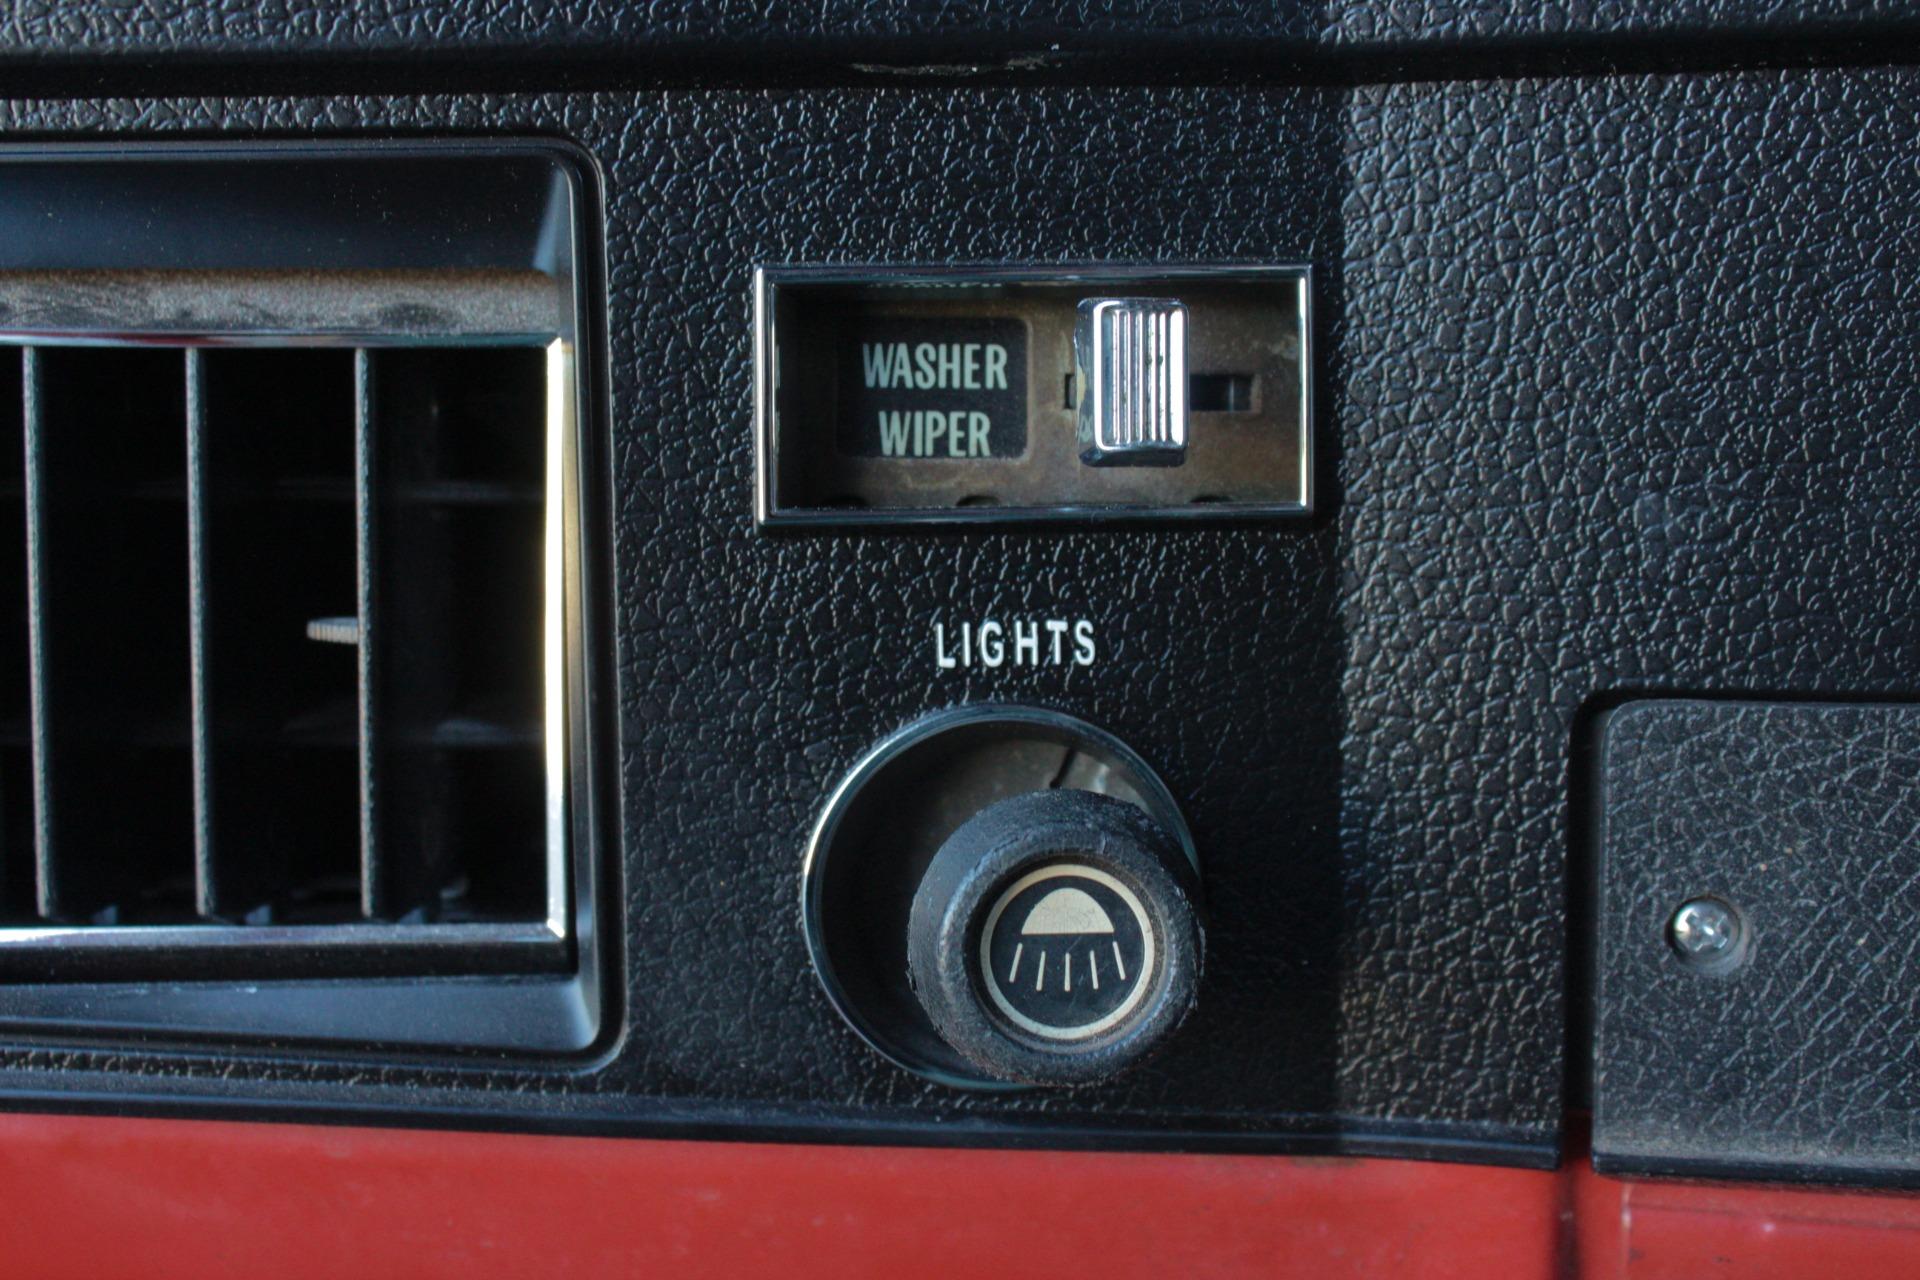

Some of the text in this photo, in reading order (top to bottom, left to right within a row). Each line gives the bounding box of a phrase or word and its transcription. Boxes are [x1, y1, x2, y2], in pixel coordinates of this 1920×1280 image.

[863, 343, 1008, 389] WASHER
[879, 411, 991, 457] WIPER
[935, 619, 1095, 668] LIGHTS
